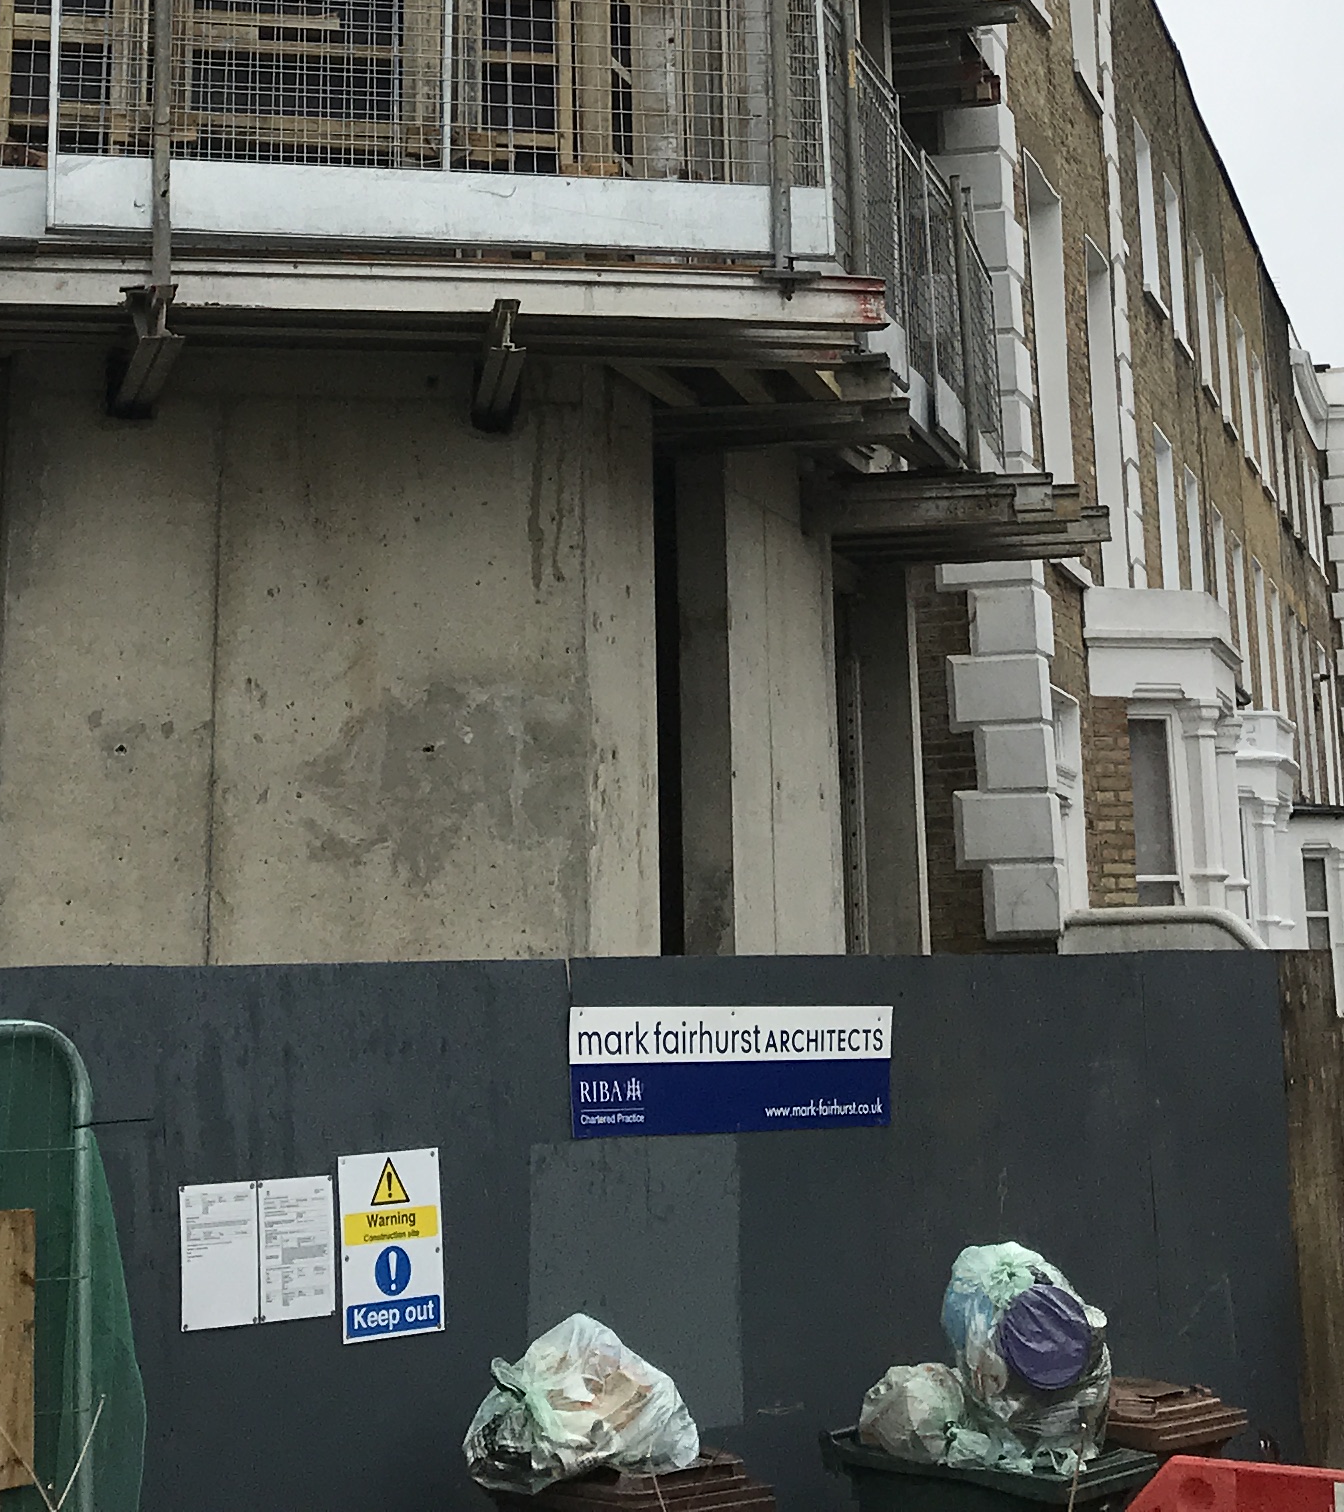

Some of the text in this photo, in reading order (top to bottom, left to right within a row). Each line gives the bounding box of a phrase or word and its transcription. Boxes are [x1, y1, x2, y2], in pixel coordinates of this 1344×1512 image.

[578, 1021, 884, 1056] mark fairhurst ARCHITECTS
[579, 1080, 623, 1103] RIBA
[580, 1112, 645, 1125] Chartered Practice
[366, 1211, 416, 1228] Warning
[353, 1300, 435, 1331] Keep out
